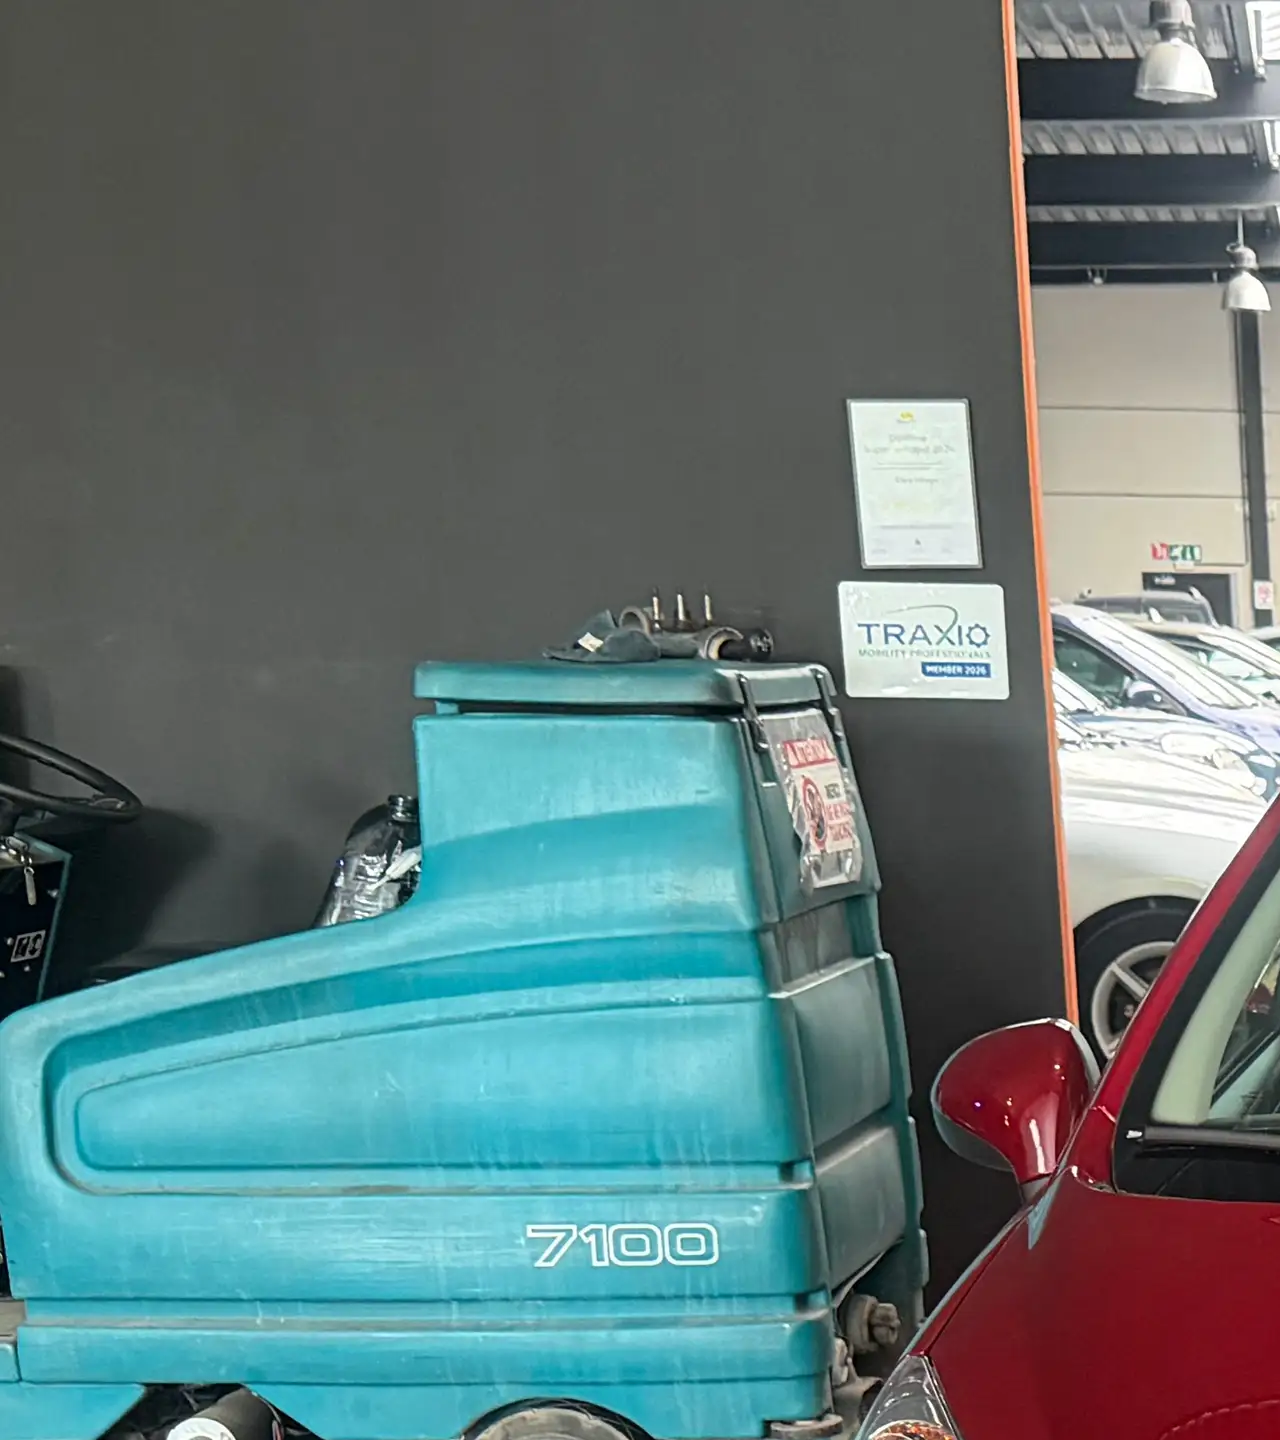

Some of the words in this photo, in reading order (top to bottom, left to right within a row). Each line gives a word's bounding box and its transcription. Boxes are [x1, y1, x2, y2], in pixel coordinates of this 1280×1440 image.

[857, 622, 991, 648] TRAXIO
[925, 665, 963, 675] MEMBER
[526, 1222, 720, 1268] 7100
